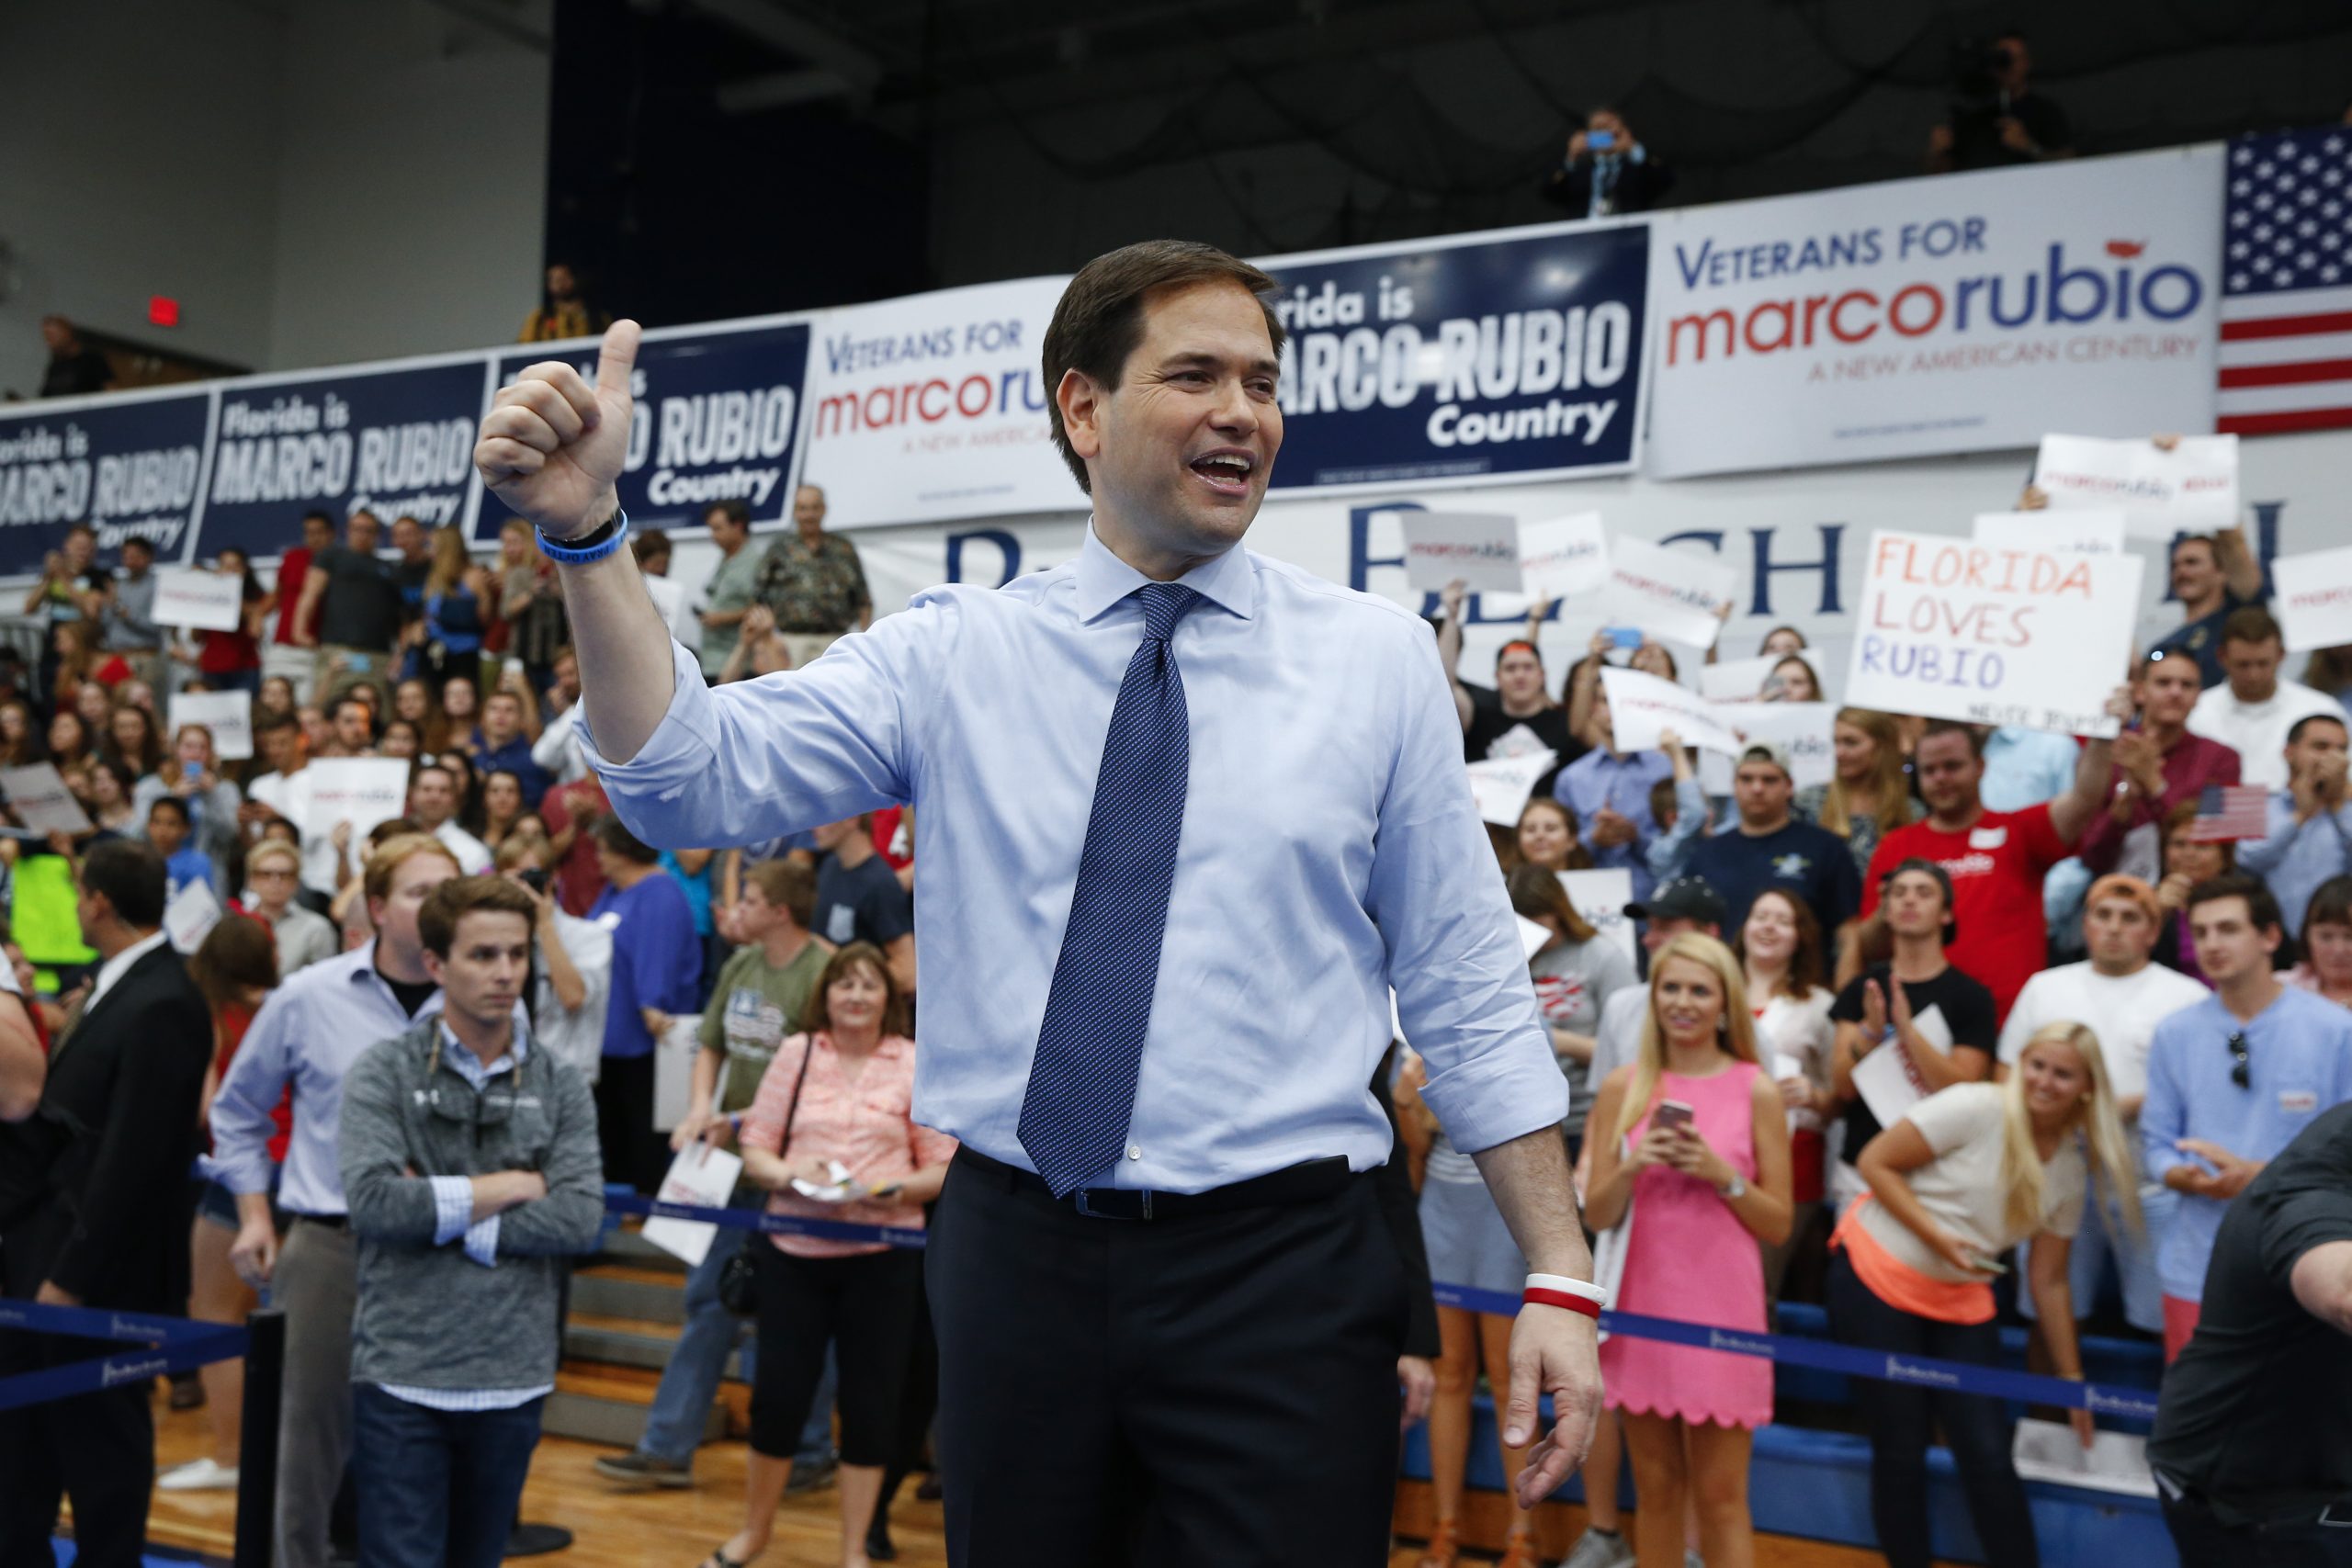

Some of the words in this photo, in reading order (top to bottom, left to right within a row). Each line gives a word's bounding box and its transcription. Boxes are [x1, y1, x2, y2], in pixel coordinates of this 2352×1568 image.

[1675, 227, 1882, 290] VETERANS
[1899, 217, 1986, 261] FOR
[1273, 280, 1364, 329] rida
[1379, 276, 1414, 321] is
[1665, 239, 2204, 367] marcorubio
[825, 327, 956, 376] VETERANS
[965, 320, 1025, 355] FOR
[1279, 323, 1422, 416] ARCO
[1435, 299, 1632, 404] RUBIO
[1834, 355, 1901, 381] NEW
[1906, 340, 2059, 372] AMERICAN
[2067, 333, 2201, 363] CENTURY
[222, 391, 320, 438] Florida
[323, 390, 350, 430] is
[655, 383, 797, 468] RUBIO
[814, 367, 1049, 441] marcoru
[1427, 399, 1619, 447] Country
[0, 458, 93, 527] ARCO
[93, 445, 199, 518] RUBIO
[210, 429, 355, 505] MARCO
[354, 414, 476, 494] RUBIO
[647, 466, 781, 506] Country
[1874, 536, 2093, 599] FLORIDA
[1873, 591, 2037, 648] LOVES
[1860, 633, 2006, 691] RUBIO
